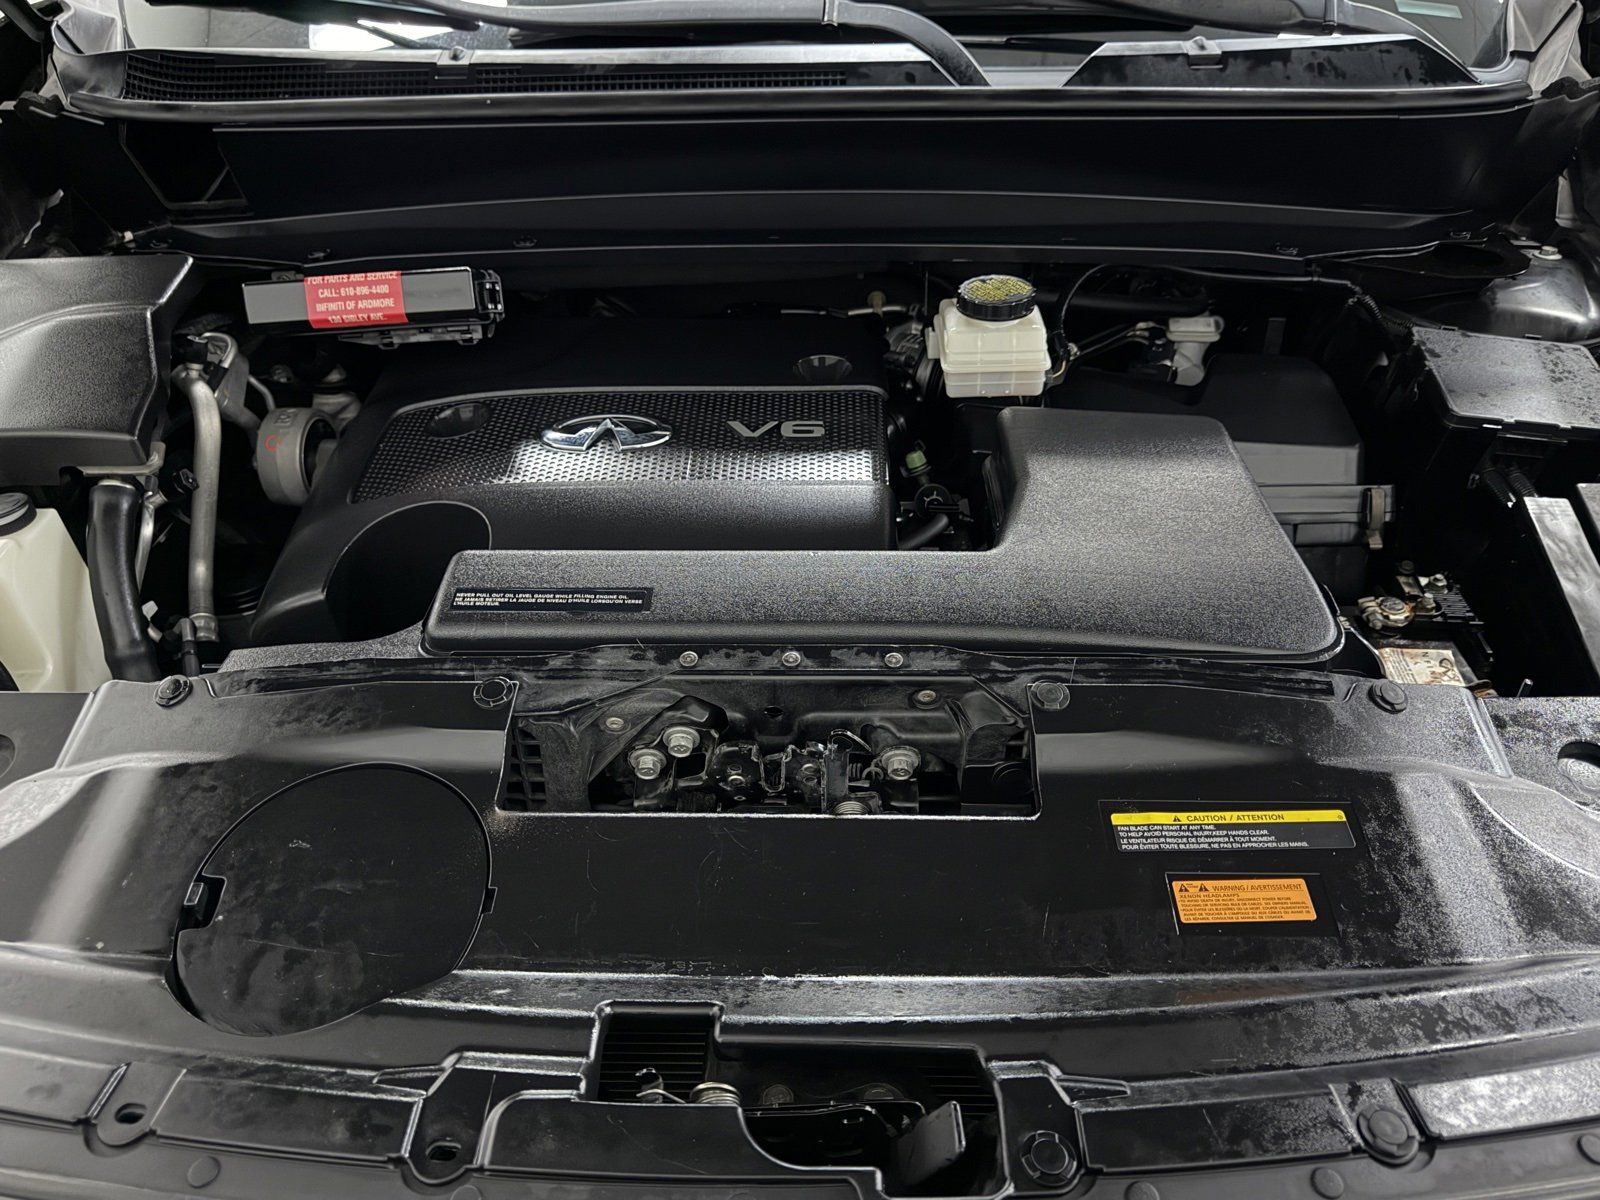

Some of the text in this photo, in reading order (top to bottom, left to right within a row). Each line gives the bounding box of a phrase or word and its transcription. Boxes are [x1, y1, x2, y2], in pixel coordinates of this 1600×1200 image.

[307, 271, 398, 285] FOR PARTS AND SERVICE
[318, 288, 339, 298] CALL:
[316, 298, 395, 312] INFINITI OF ARDMORE
[726, 420, 825, 438] V6
